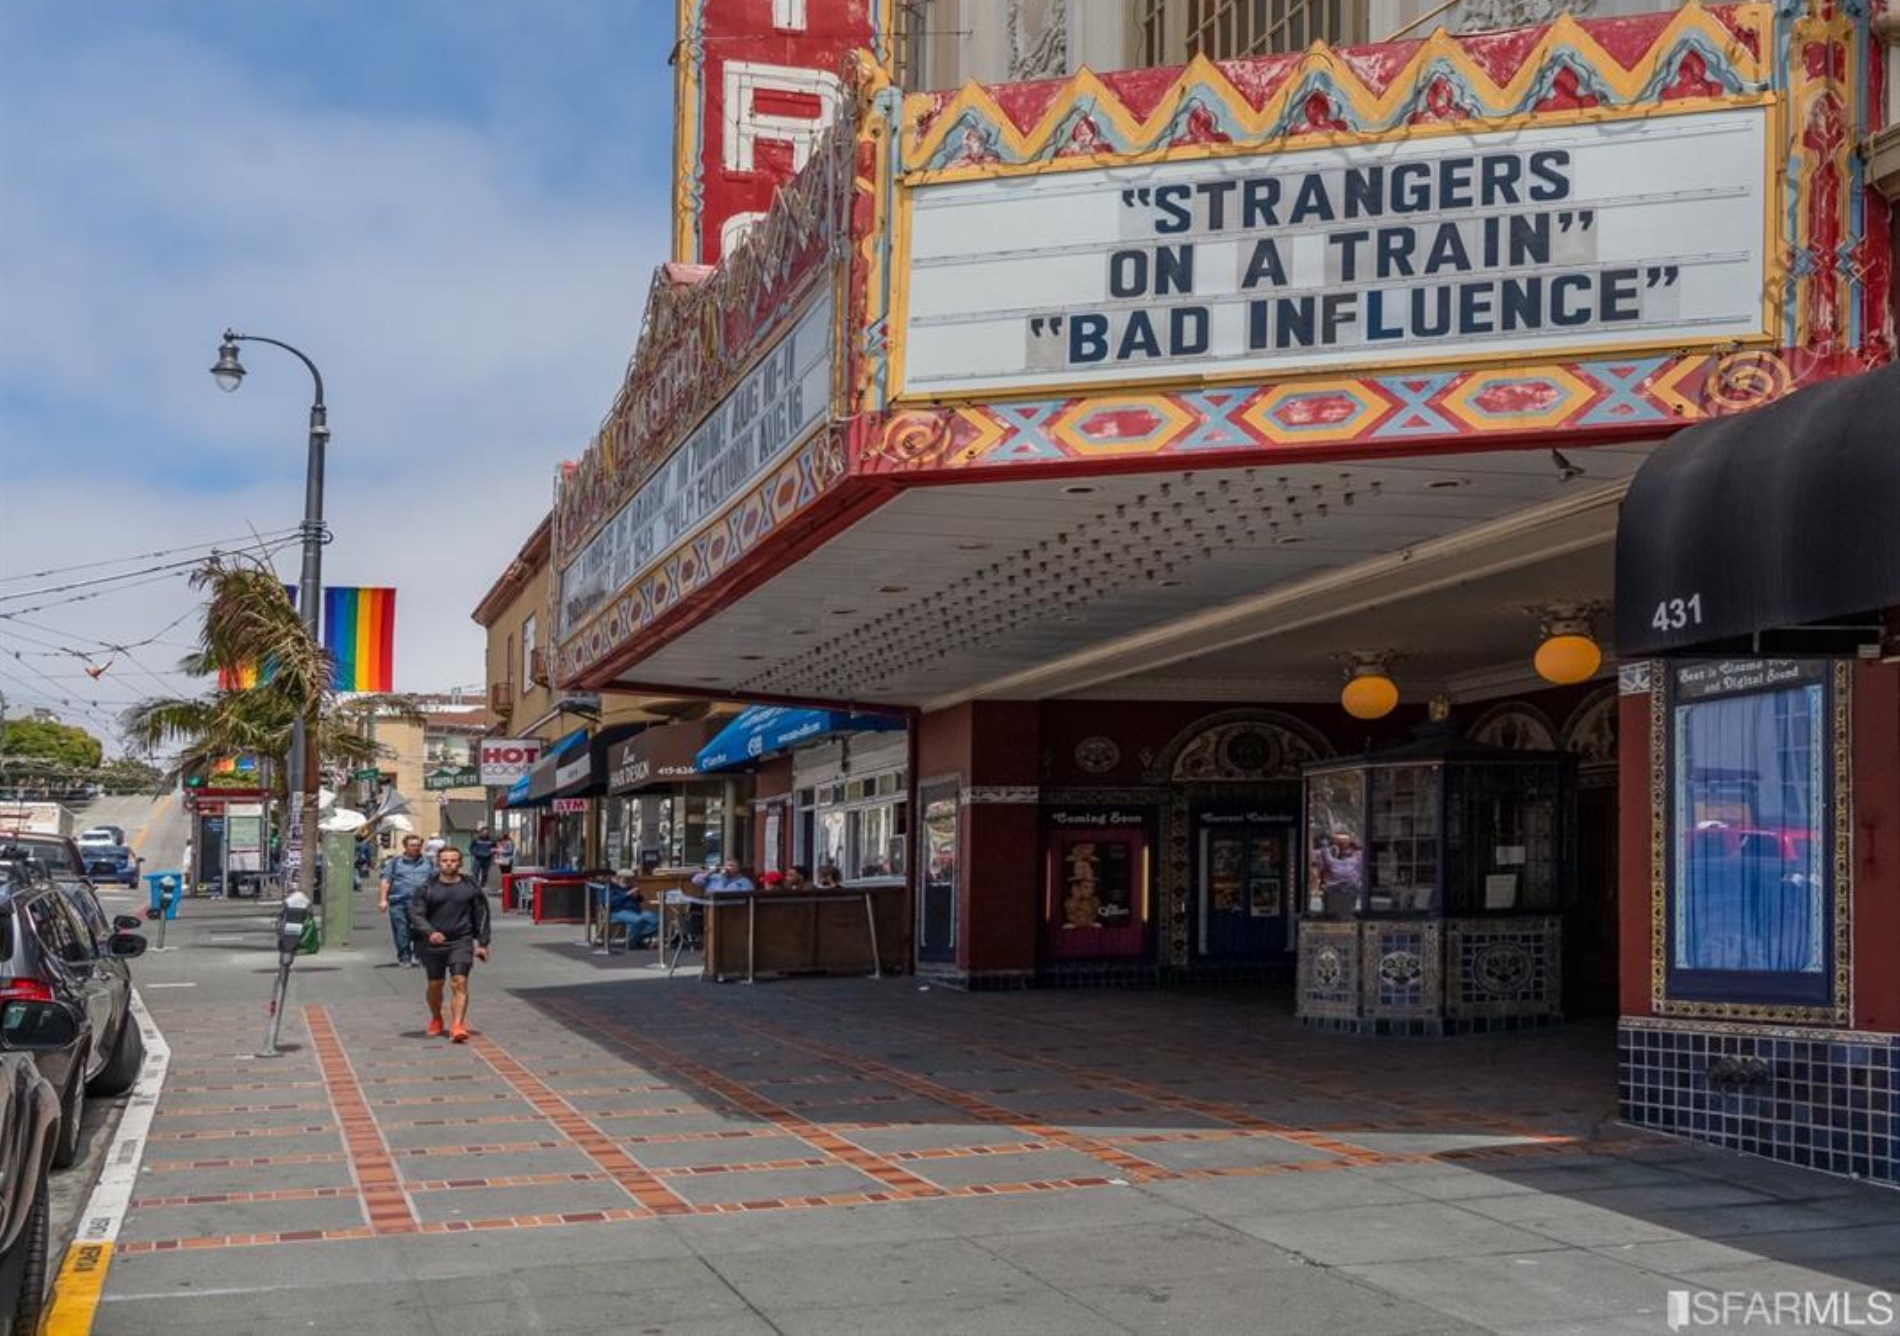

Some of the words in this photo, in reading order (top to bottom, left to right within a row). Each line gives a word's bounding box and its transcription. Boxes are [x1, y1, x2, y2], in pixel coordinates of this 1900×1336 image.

[1122, 150, 1571, 233] "STRANGERS
[1110, 244, 1193, 298] ON
[1241, 238, 1287, 288] A
[1328, 211, 1594, 281] TRAIN"
[1030, 306, 1209, 364] "BAD
[1249, 266, 1679, 350] INFLUENCE"
[732, 375, 758, 438] AUG
[763, 334, 796, 406] 10-11
[759, 399, 787, 462] AUG
[788, 382, 803, 435] 16
[1653, 592, 1702, 631] 431
[1723, 671, 1763, 690] Digital
[1766, 666, 1799, 683] Sound
[482, 748, 539, 763] HOT
[555, 799, 586, 812] ATM
[1053, 812, 1106, 824] Coming
[1110, 812, 1142, 823] Soon
